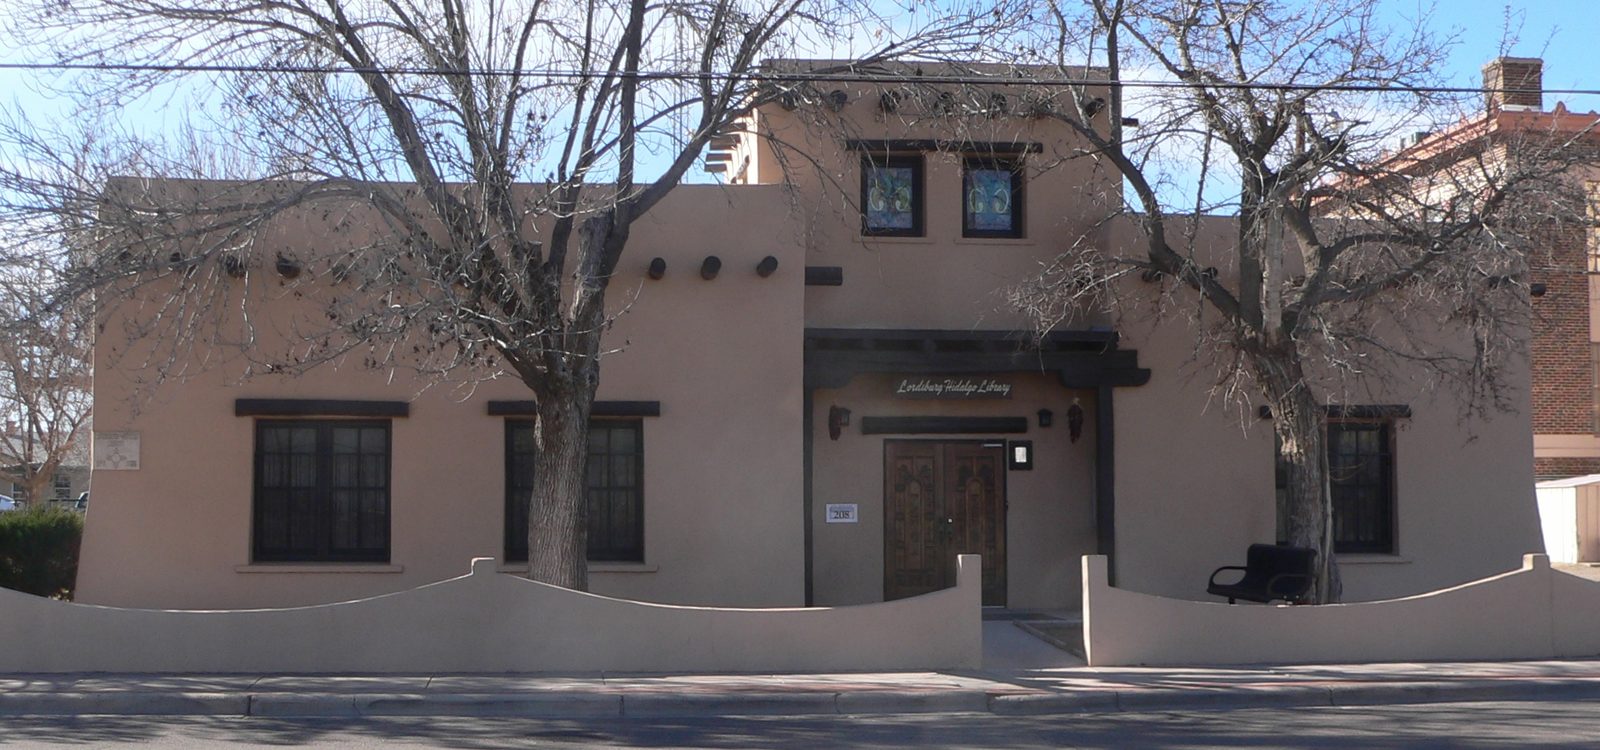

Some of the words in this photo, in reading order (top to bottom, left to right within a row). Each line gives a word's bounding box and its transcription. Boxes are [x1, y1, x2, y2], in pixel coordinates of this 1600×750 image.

[943, 379, 978, 395] Hidalgo
[977, 379, 1010, 395] Library
[833, 510, 850, 519] 208
